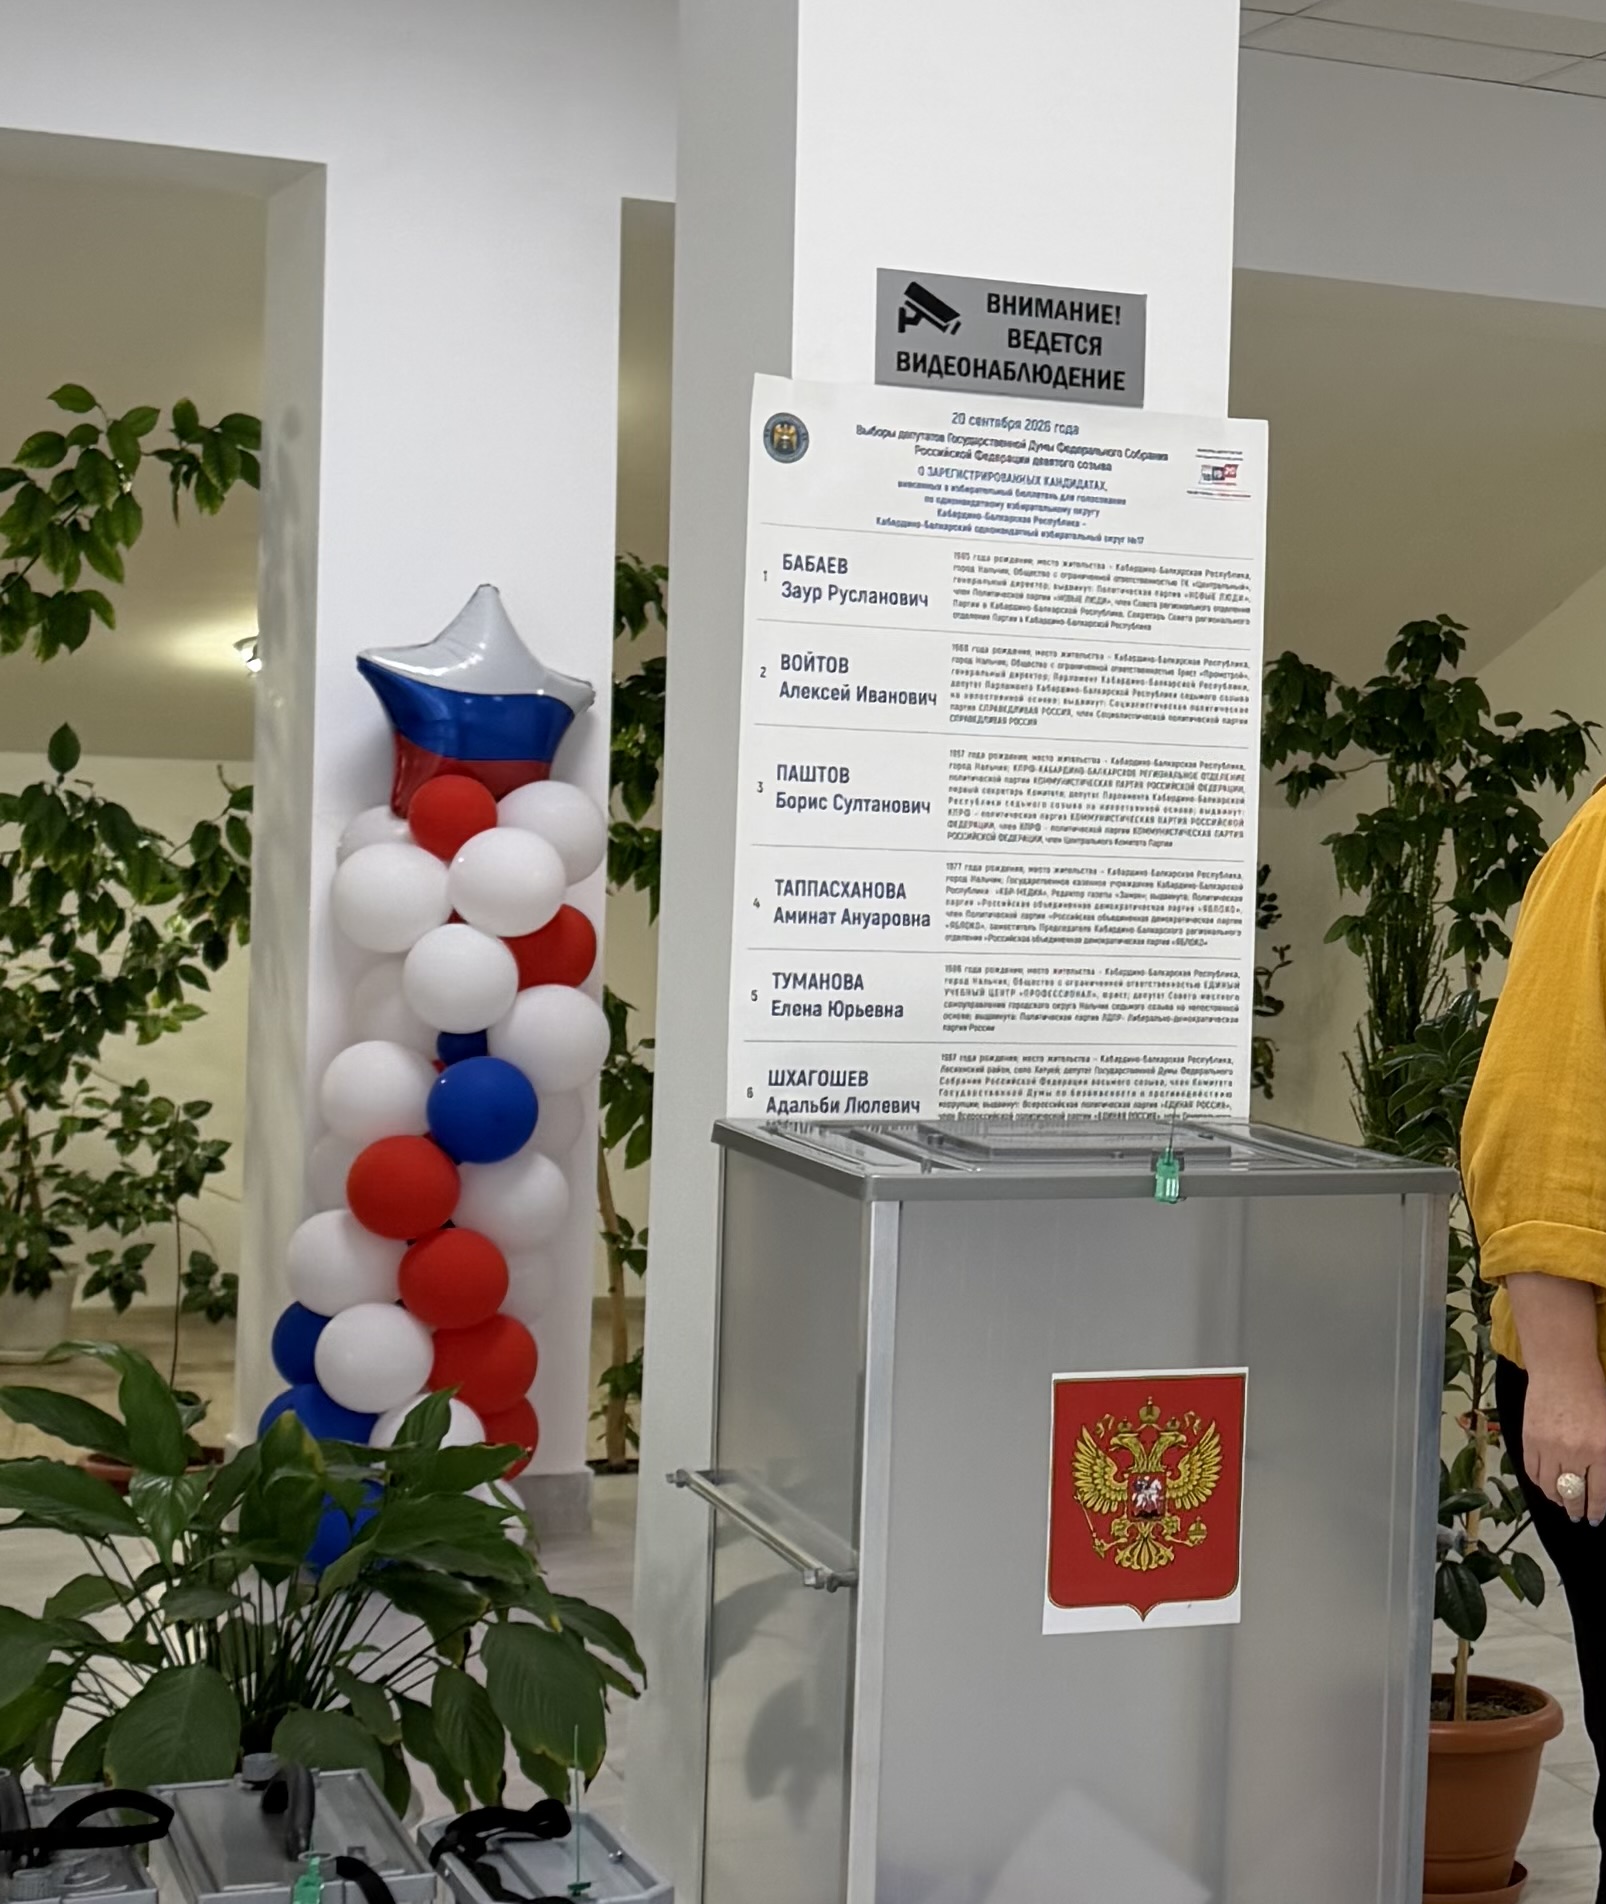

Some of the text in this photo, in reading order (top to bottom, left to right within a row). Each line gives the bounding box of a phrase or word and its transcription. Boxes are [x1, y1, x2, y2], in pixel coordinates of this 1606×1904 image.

[987, 293, 1121, 326] ВНИМАНИЕ!
[1007, 328, 1102, 356] ВЕДЕТСЯ
[896, 351, 1126, 391] ВИДЕОНАБЛЮДЕНИЕ
[951, 411, 966, 426] 20
[968, 415, 1022, 432] сентября
[1023, 418, 1052, 433] 2026
[917, 465, 925, 477] О
[927, 465, 1042, 486] ЗАРЕГИСТРИРОВАННЫХ
[782, 553, 848, 575] БАБАЕВ
[781, 581, 929, 607] Заур Русланович
[760, 666, 767, 678] 2
[780, 651, 849, 674] ВОЙТОВ
[779, 681, 938, 706] Алексей Иванович
[776, 764, 850, 784] ПАШТОВ
[756, 781, 764, 793] 3
[776, 791, 931, 815] Борис Султанович
[774, 879, 907, 900] ТАППАСХАНОВА
[753, 898, 761, 908] 4
[773, 906, 931, 929] Аминат Ануаровна
[772, 971, 864, 991] ТУМАНОВА
[751, 989, 758, 1002] 5
[771, 999, 904, 1021] Елена Юрьевна
[768, 1069, 869, 1087] ШХАГОШЕВ
[746, 1087, 754, 1099] 6
[766, 1096, 921, 1116] Адальби Люлевич
